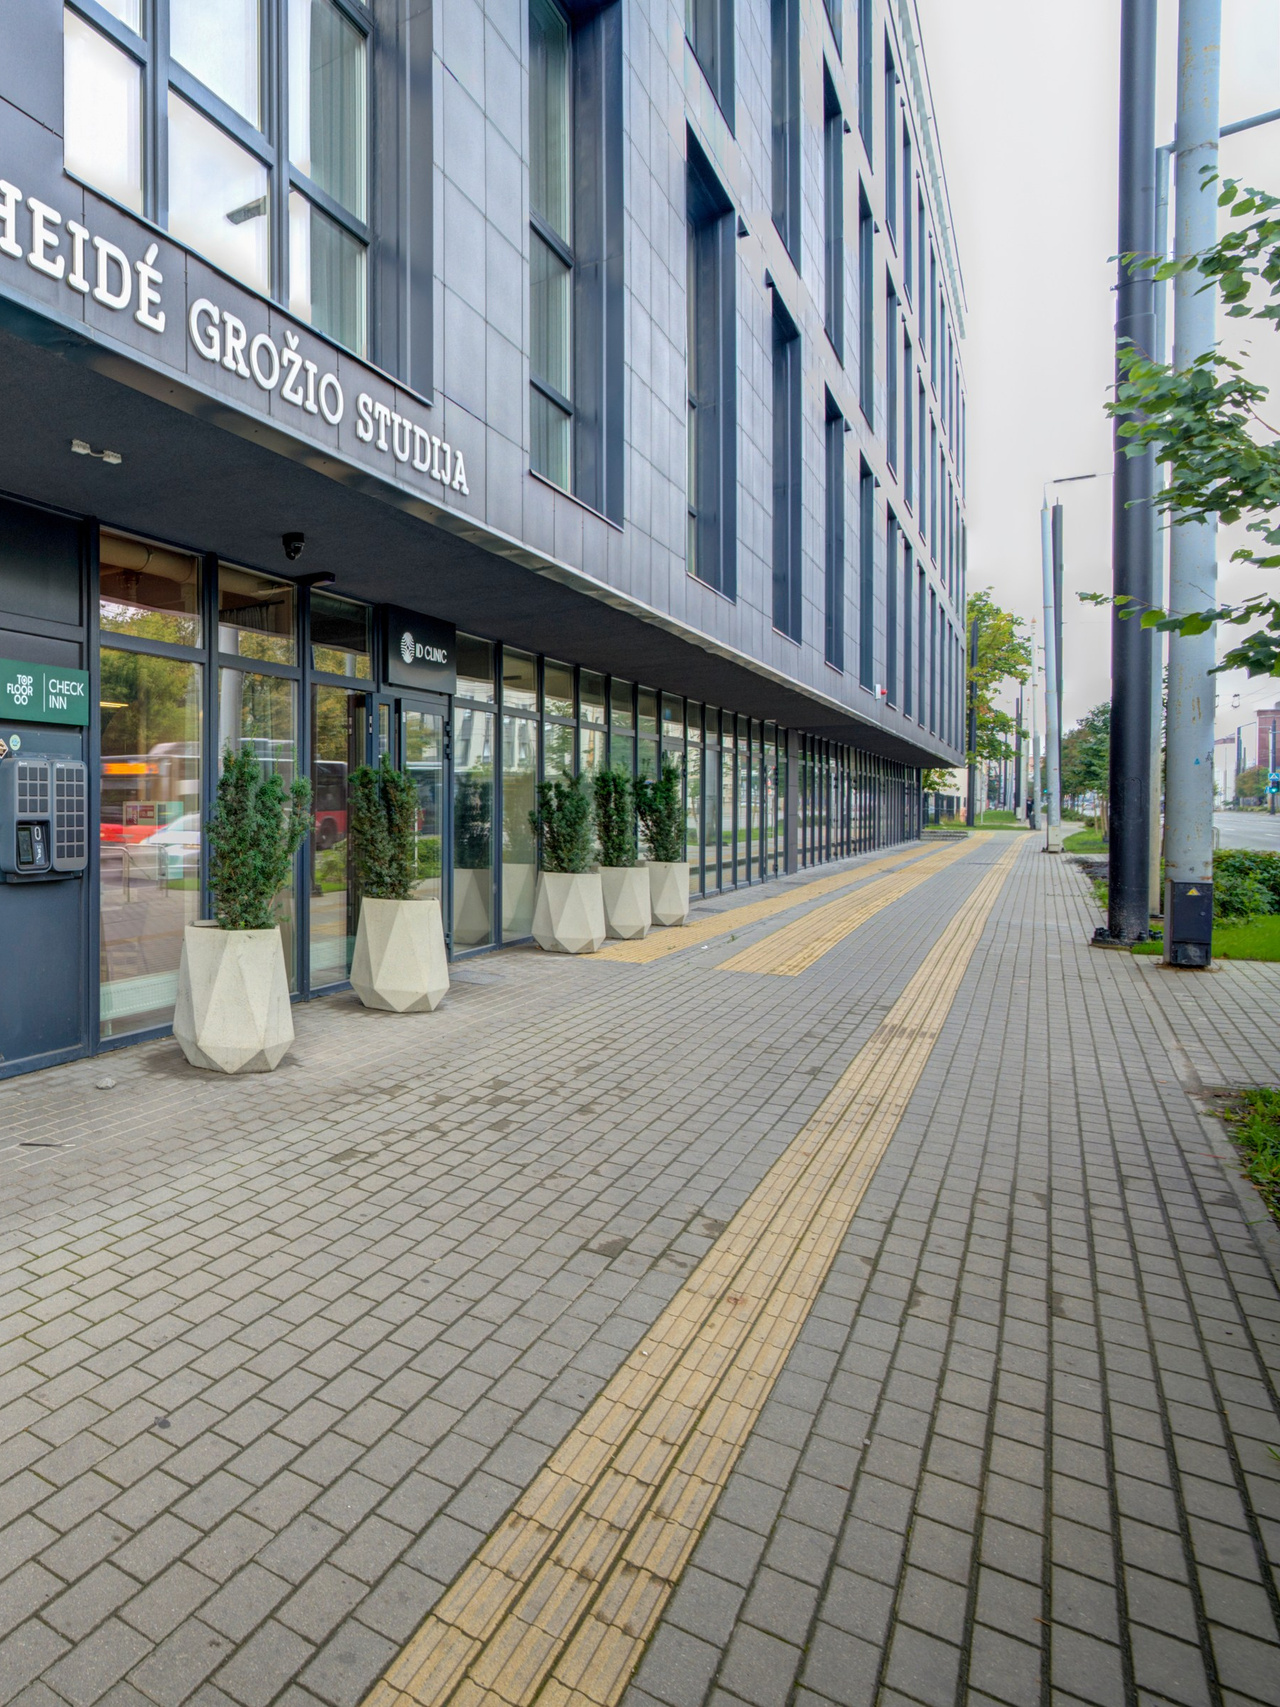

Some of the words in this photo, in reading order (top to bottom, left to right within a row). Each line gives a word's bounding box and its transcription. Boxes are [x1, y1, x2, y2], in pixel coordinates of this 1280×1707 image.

[189, 298, 344, 426] GROŽIO
[356, 392, 470, 496] STUDIJA
[415, 643, 424, 658] ID
[424, 645, 448, 664] CLINIC
[16, 674, 33, 686] TOP
[48, 679, 84, 697] CHECK
[6, 683, 33, 696] FLOOR
[48, 695, 67, 710] INN
